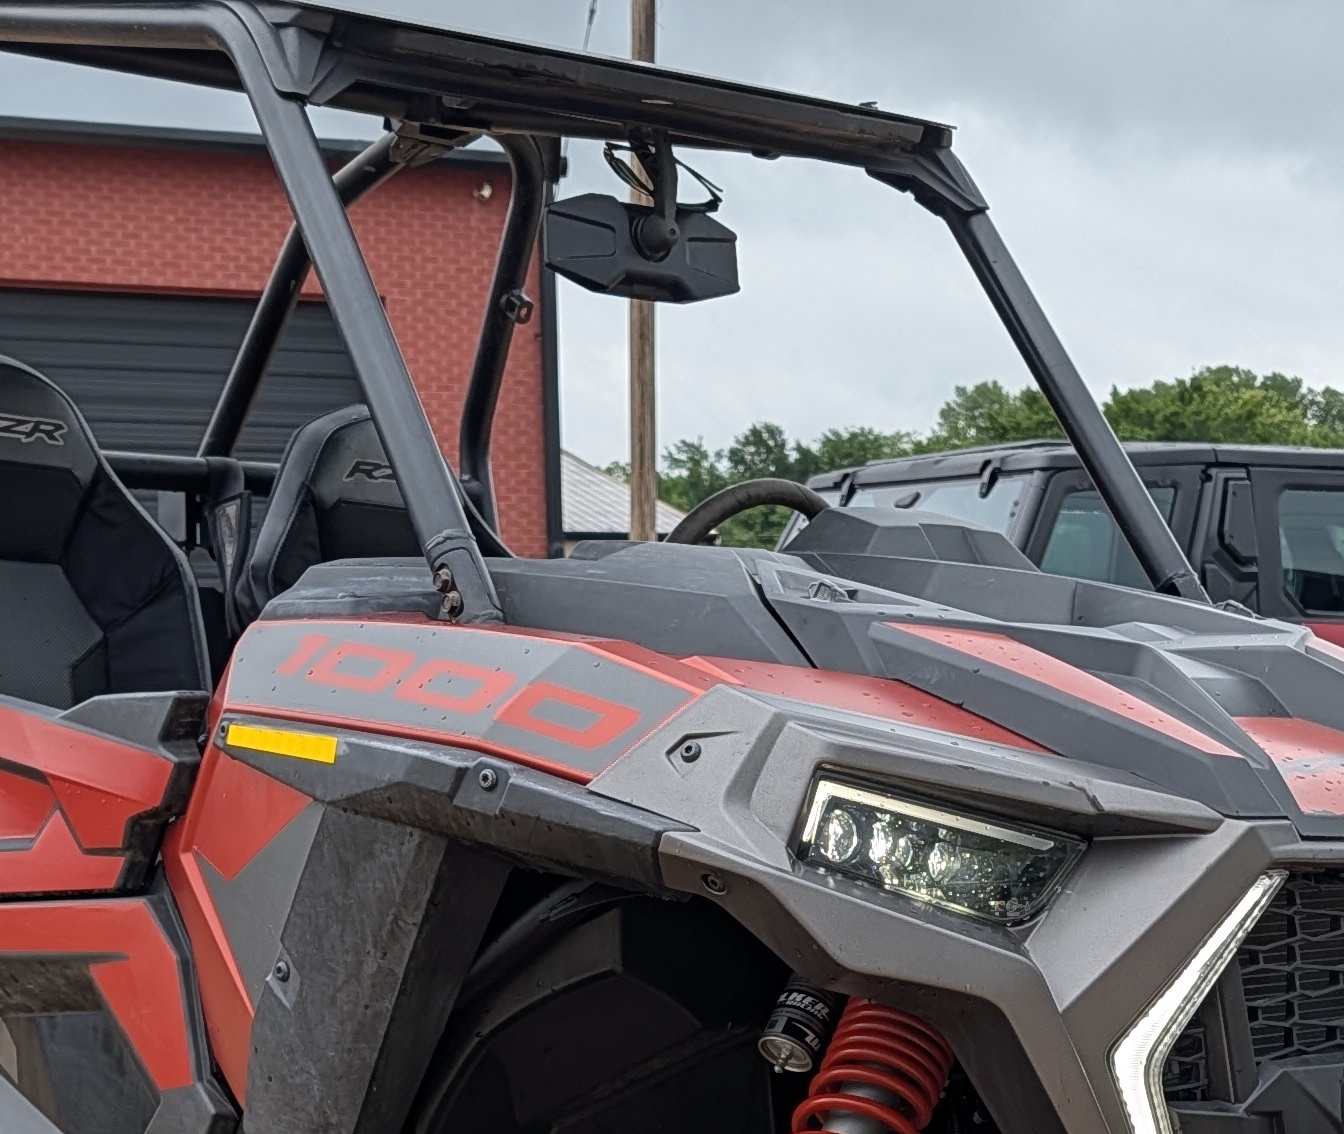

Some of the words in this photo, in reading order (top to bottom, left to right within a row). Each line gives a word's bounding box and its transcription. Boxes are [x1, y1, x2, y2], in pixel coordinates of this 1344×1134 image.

[342, 459, 396, 483] RZ
[278, 633, 641, 749] 1000
[778, 992, 830, 1022] LKER
